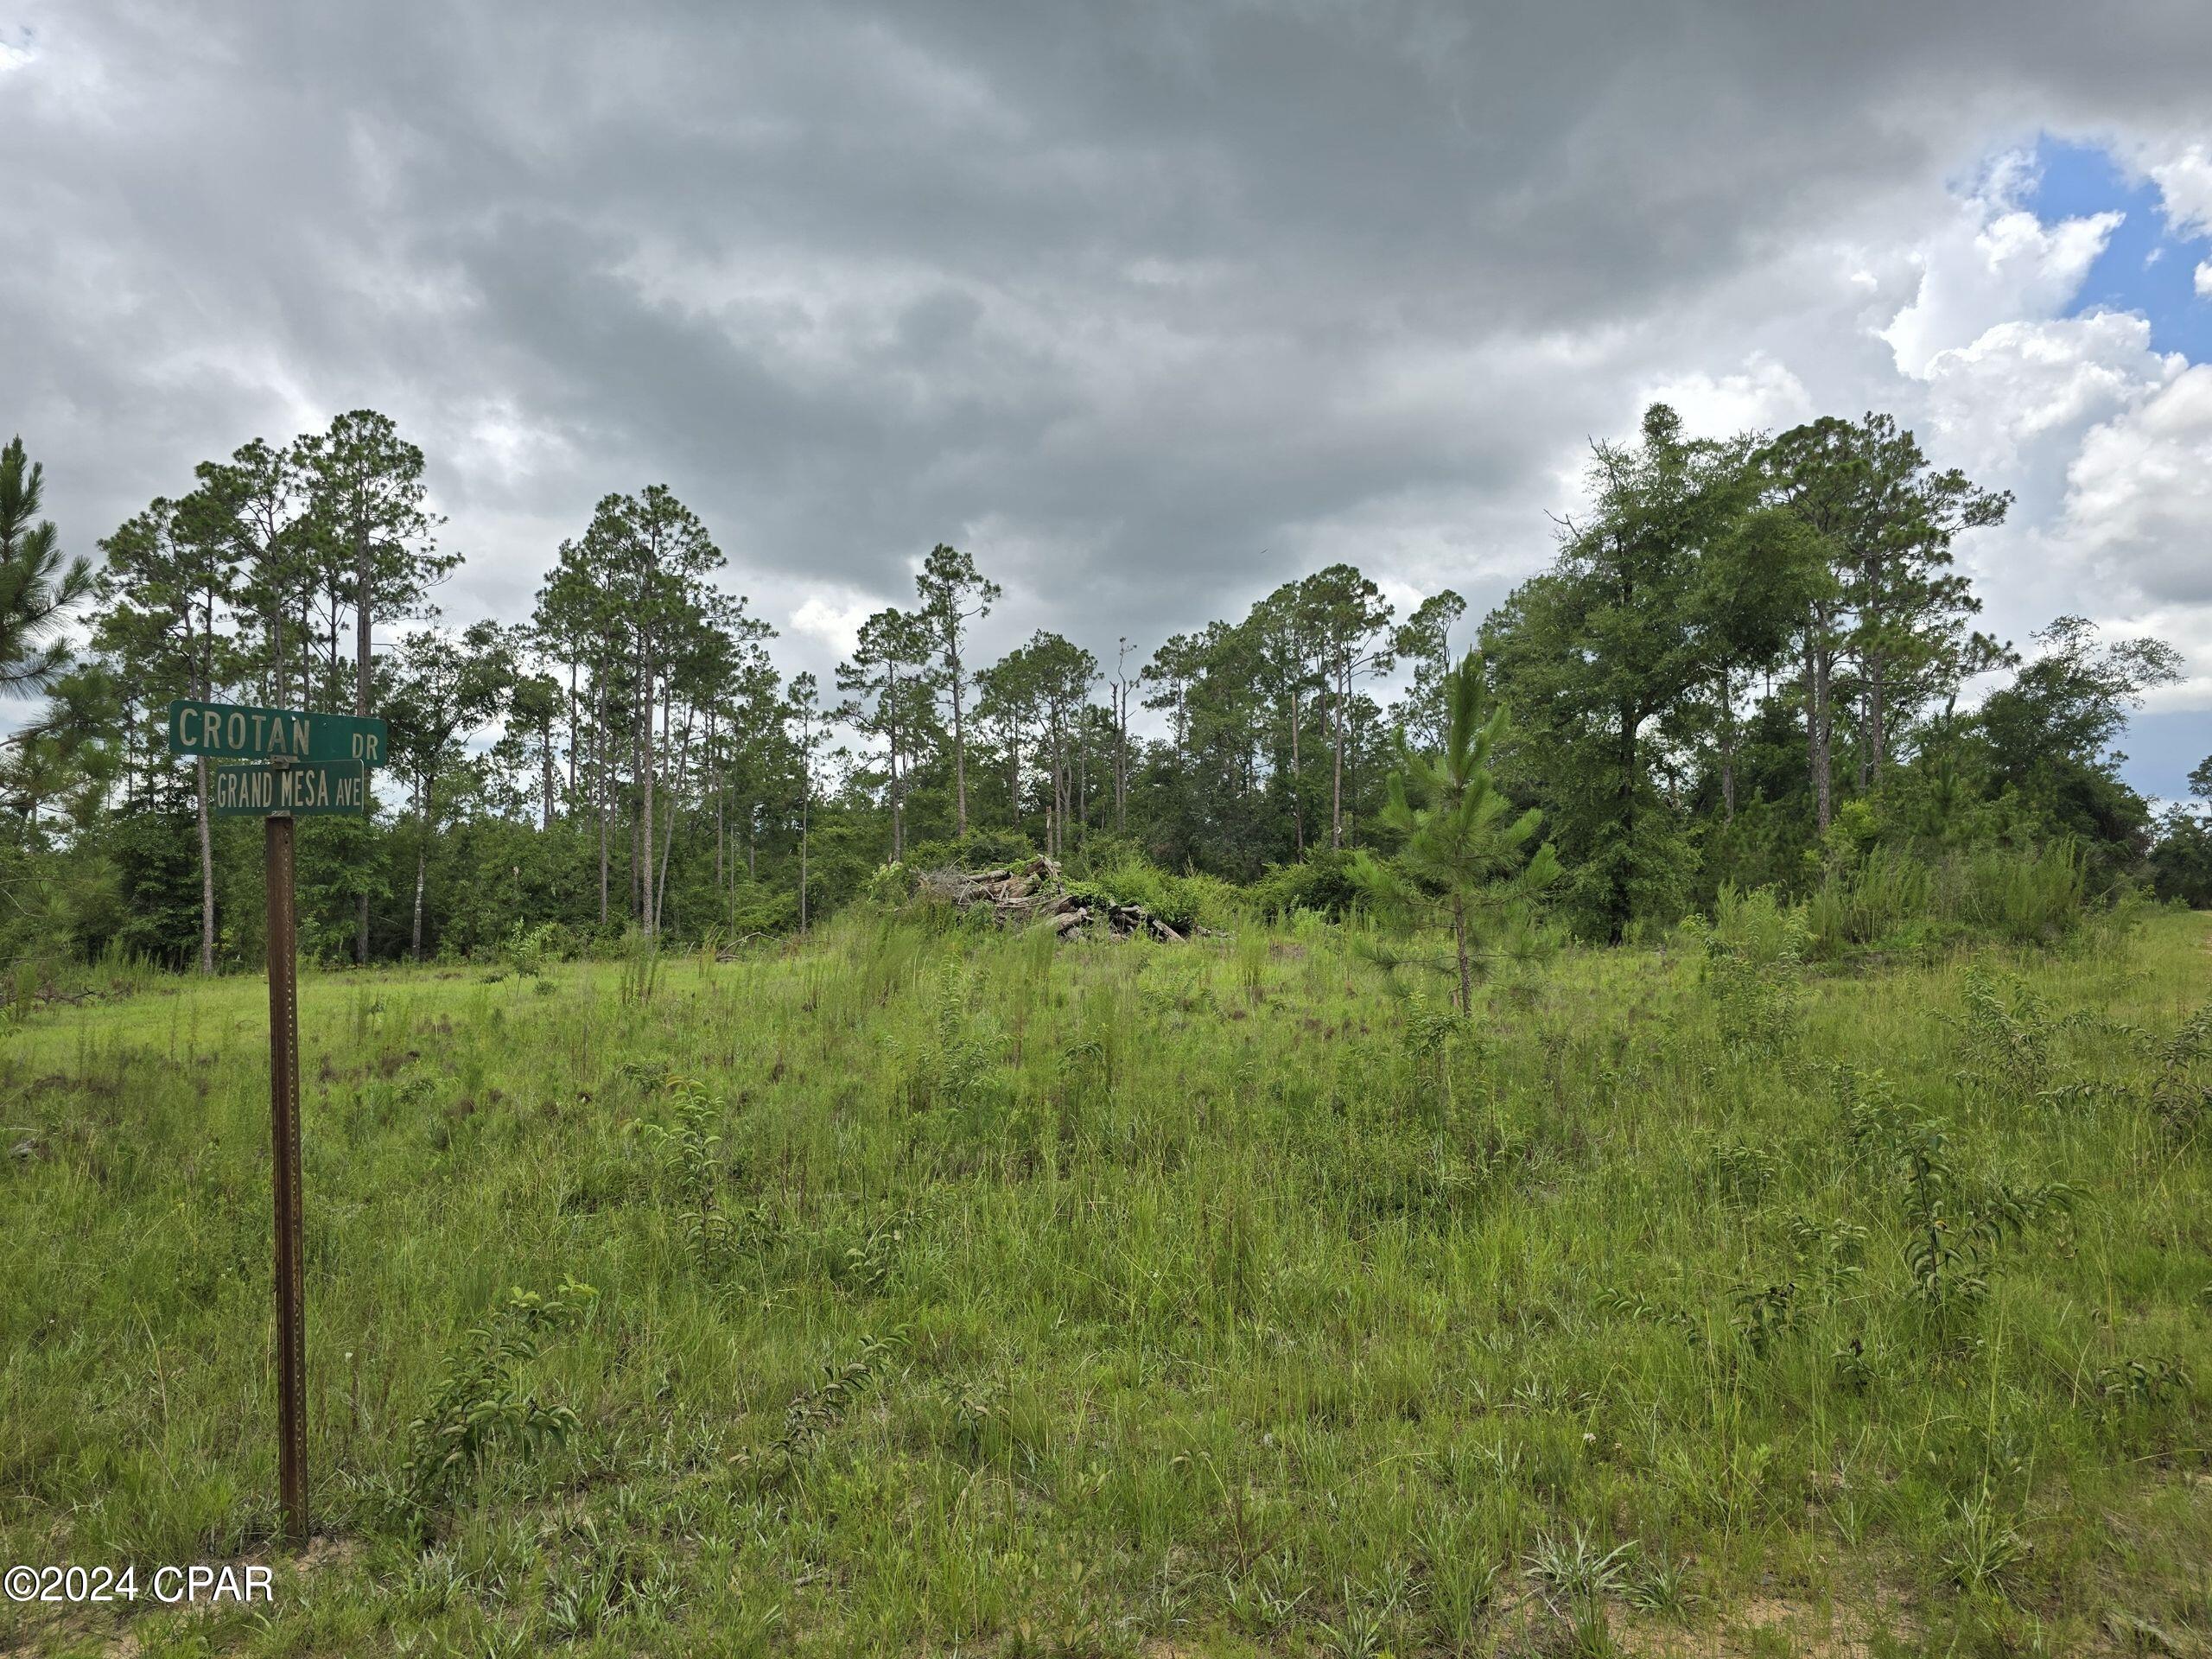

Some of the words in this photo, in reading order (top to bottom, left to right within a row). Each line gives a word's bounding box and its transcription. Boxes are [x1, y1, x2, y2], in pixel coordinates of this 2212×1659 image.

[180, 708, 310, 755] CROTAN
[352, 733, 378, 760] DR
[218, 772, 272, 808] GRAND
[281, 770, 328, 807] MESA
[335, 778, 361, 806] AVE
